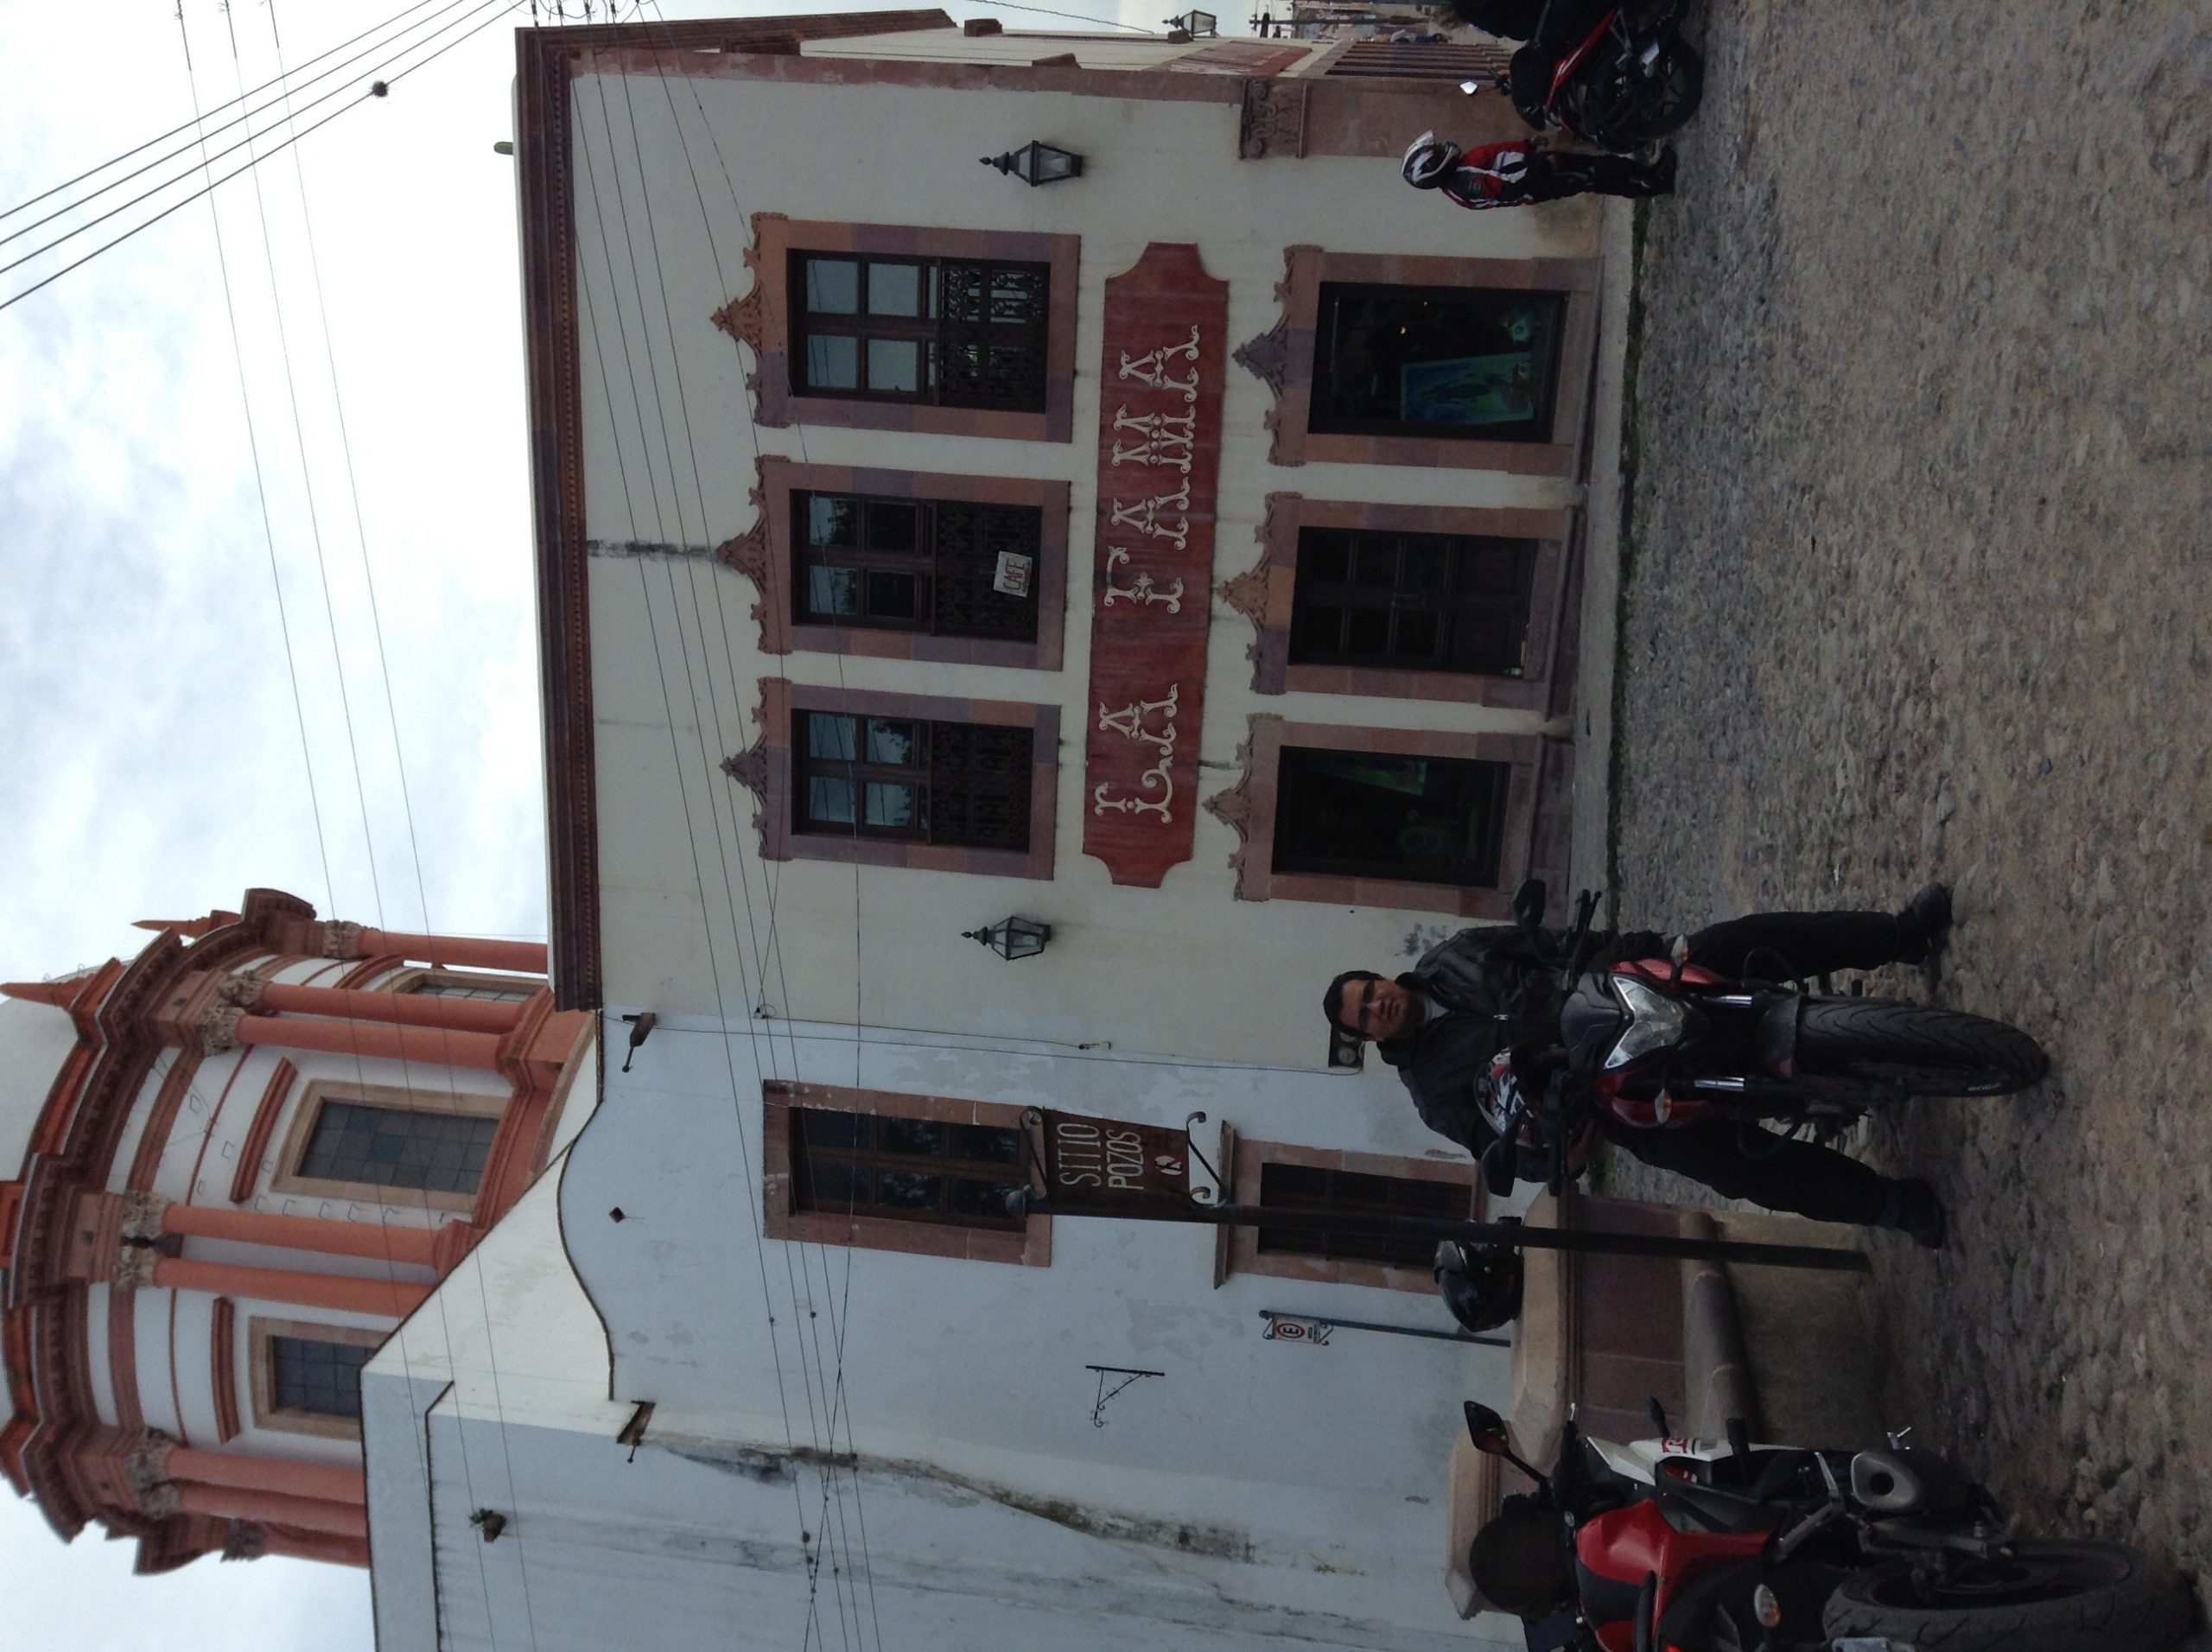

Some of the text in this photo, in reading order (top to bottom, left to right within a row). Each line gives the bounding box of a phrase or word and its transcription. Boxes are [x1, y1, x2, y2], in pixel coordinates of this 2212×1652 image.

[1095, 325, 1199, 823] LA FAMA
[1057, 1122, 1102, 1186] SITIO
[1106, 1129, 1145, 1191] POZOS
